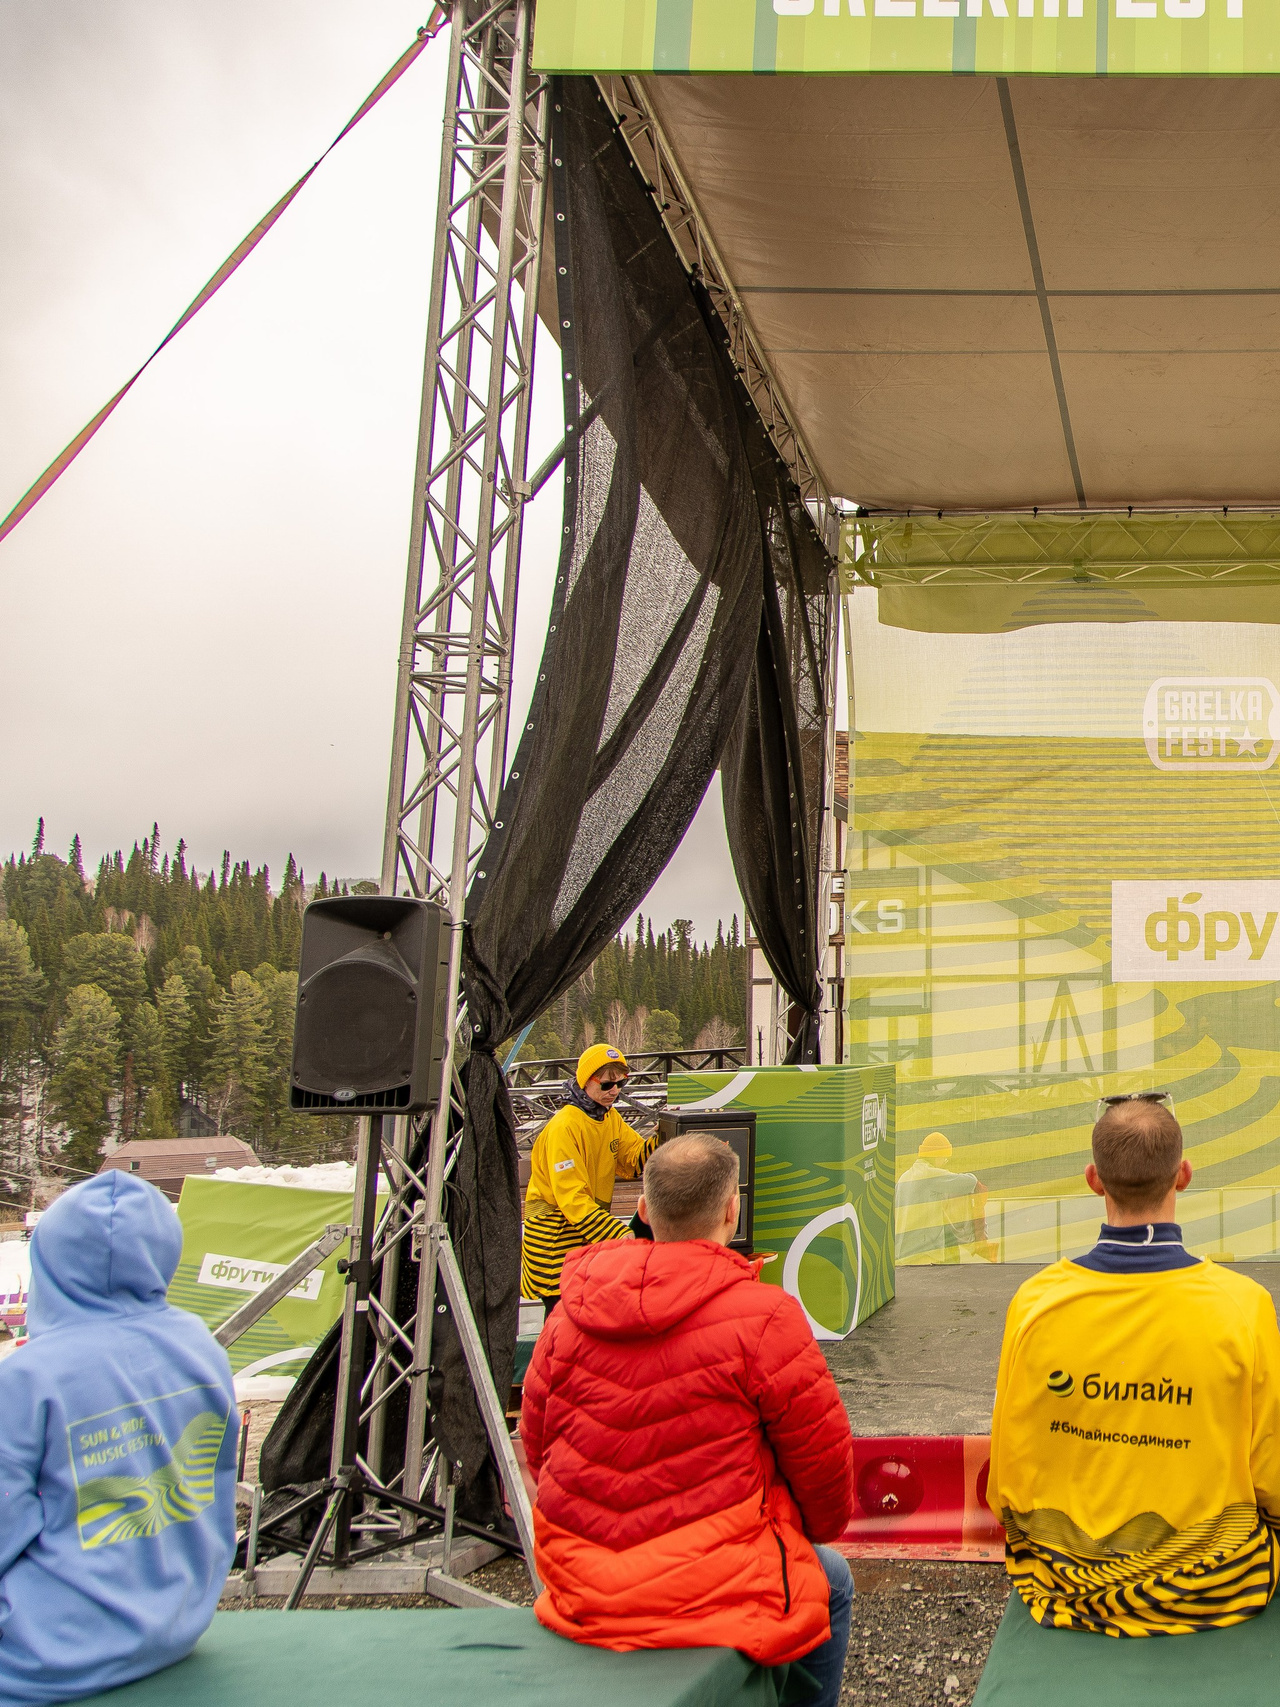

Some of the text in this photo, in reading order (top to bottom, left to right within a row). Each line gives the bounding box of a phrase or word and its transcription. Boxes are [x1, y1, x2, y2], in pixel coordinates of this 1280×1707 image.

[1164, 691, 1263, 722] GRELKA
[1165, 726, 1232, 757] FEST
[211, 1260, 313, 1292] фрутид
[1082, 1373, 1193, 1406] билайн
[79, 1428, 109, 1451] SUN
[1050, 1420, 1191, 1450] #билайнсоединяет
[82, 1443, 128, 1468] MUSIC
